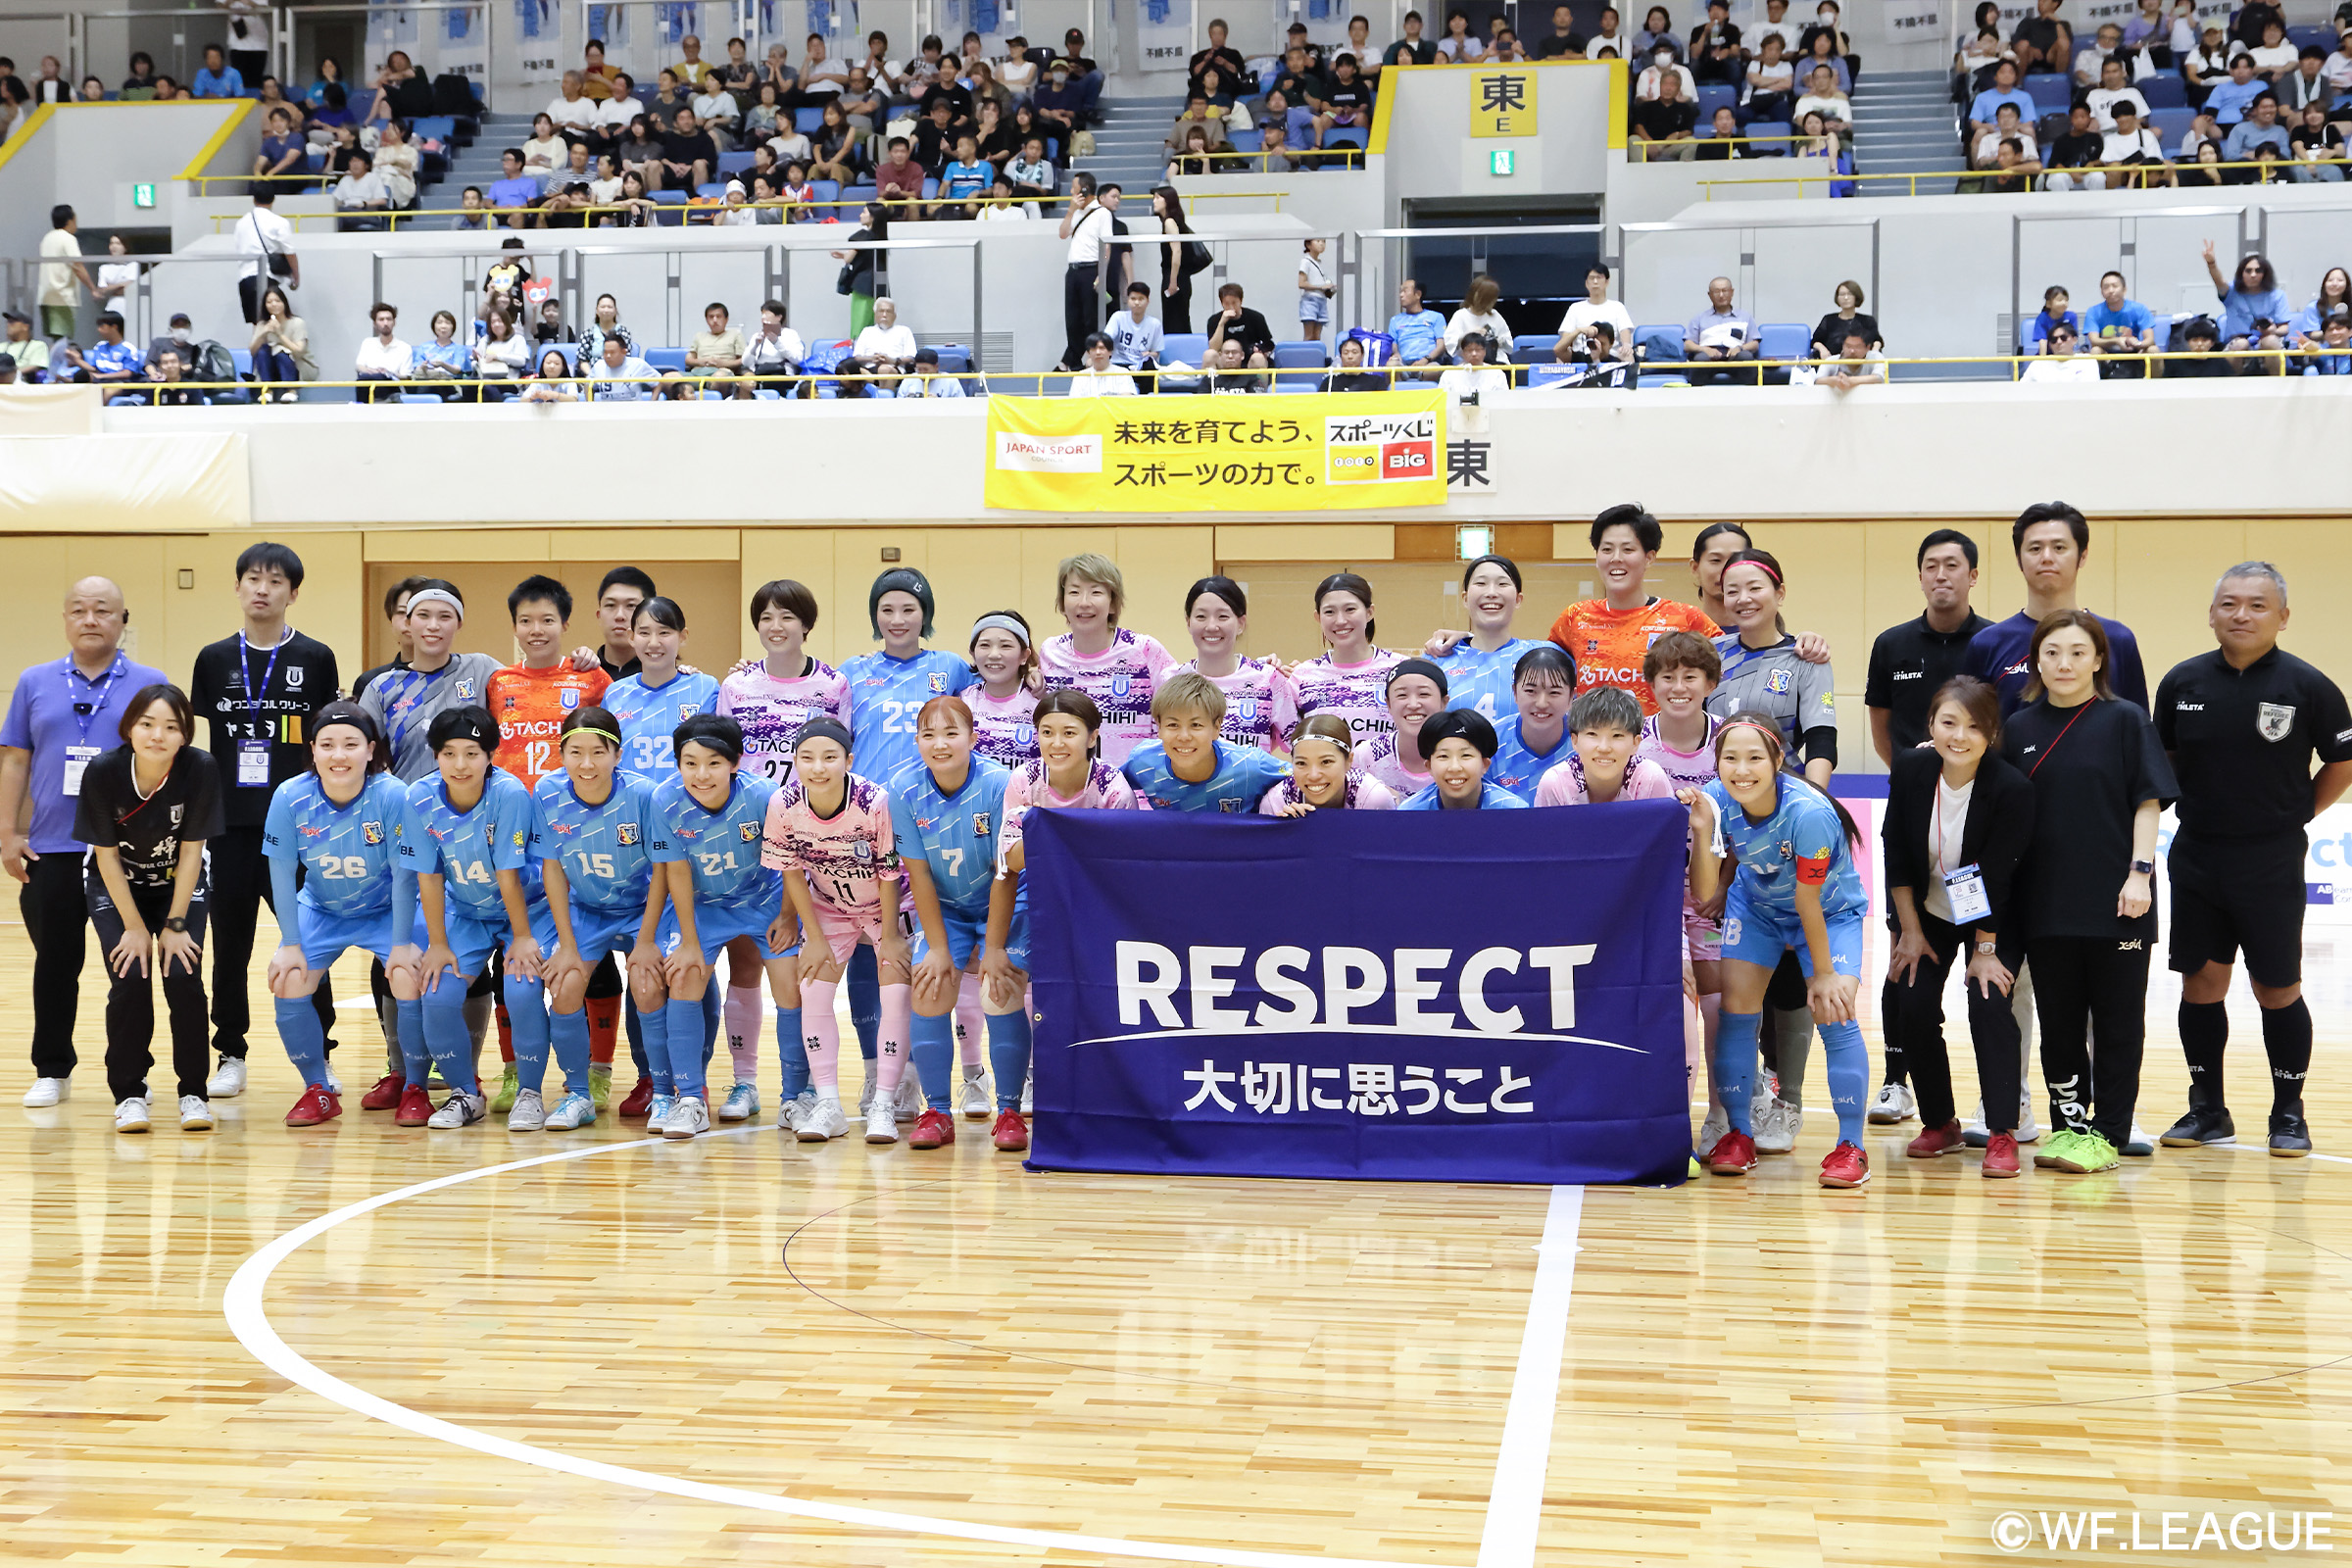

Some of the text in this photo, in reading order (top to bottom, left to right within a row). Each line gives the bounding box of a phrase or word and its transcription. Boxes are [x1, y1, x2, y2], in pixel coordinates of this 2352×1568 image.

[1481, 74, 1526, 112] 東
[1496, 117, 1511, 131] E
[1113, 419, 1313, 444] 未来を育てよう、
[1330, 418, 1433, 442] スポーツくじ
[1006, 442, 1092, 455] JAPAN SPORT
[1113, 461, 1314, 487] スポーツの力で。
[1447, 439, 1491, 486] 東
[882, 701, 925, 733] 23
[1473, 693, 1496, 723] 4
[513, 721, 561, 735] TACH
[524, 741, 551, 775] 12
[632, 735, 675, 769] 32
[764, 760, 793, 788] 27
[319, 856, 368, 879] 26
[451, 859, 492, 886] 14
[578, 853, 615, 878] 15
[700, 852, 739, 876] 21
[941, 848, 963, 877] 7
[832, 879, 857, 903] 11
[1116, 941, 1597, 1032] RESPECT
[1183, 1059, 1534, 1115] 大切に思うこと
